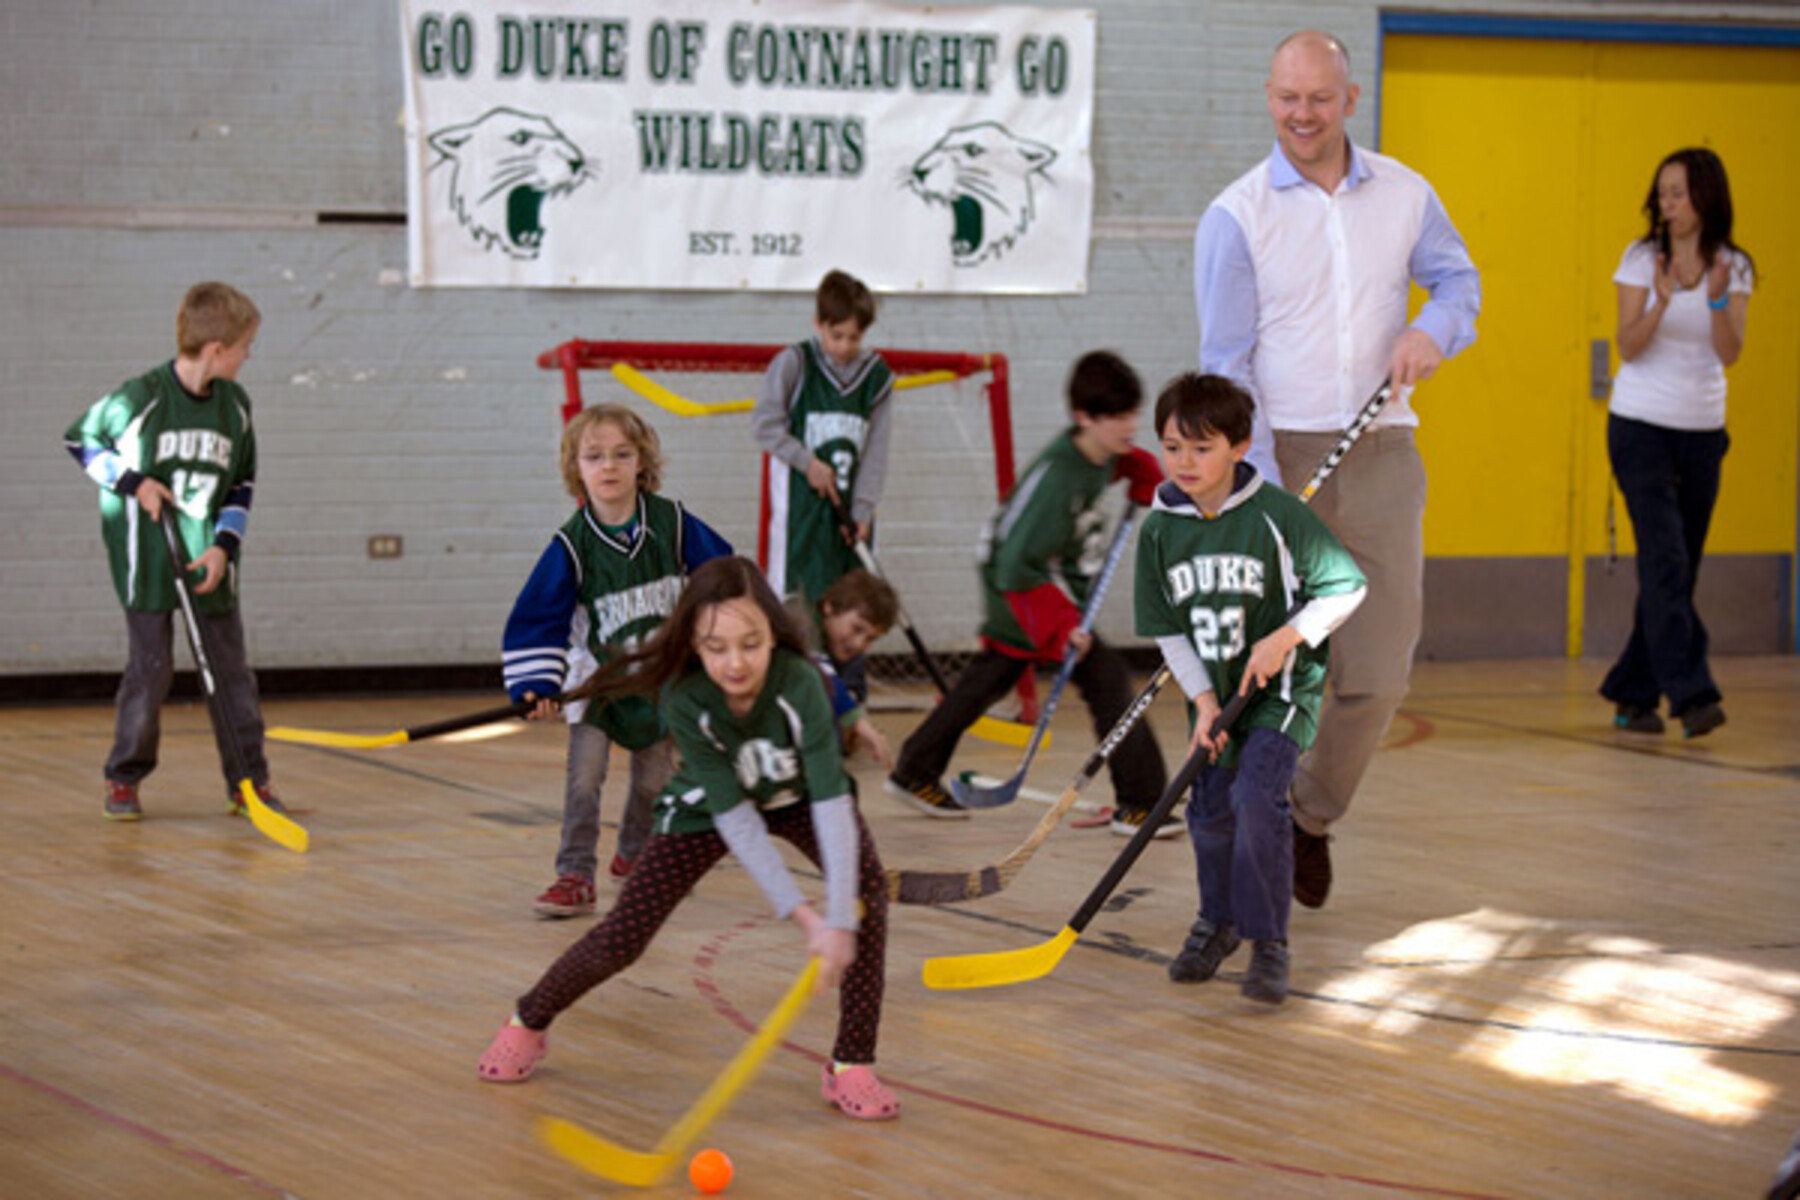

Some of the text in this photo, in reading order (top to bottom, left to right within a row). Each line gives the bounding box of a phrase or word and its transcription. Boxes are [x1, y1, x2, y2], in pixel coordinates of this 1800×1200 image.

[415, 15, 1069, 96] GO DUKE OF CONNAUGHT GO
[634, 110, 865, 178] WILDCATS
[688, 232, 803, 256] EST. 1912
[156, 428, 233, 470] DUKE
[171, 470, 218, 520] 17
[1168, 553, 1264, 606] DUKE
[1190, 607, 1245, 661] 23
